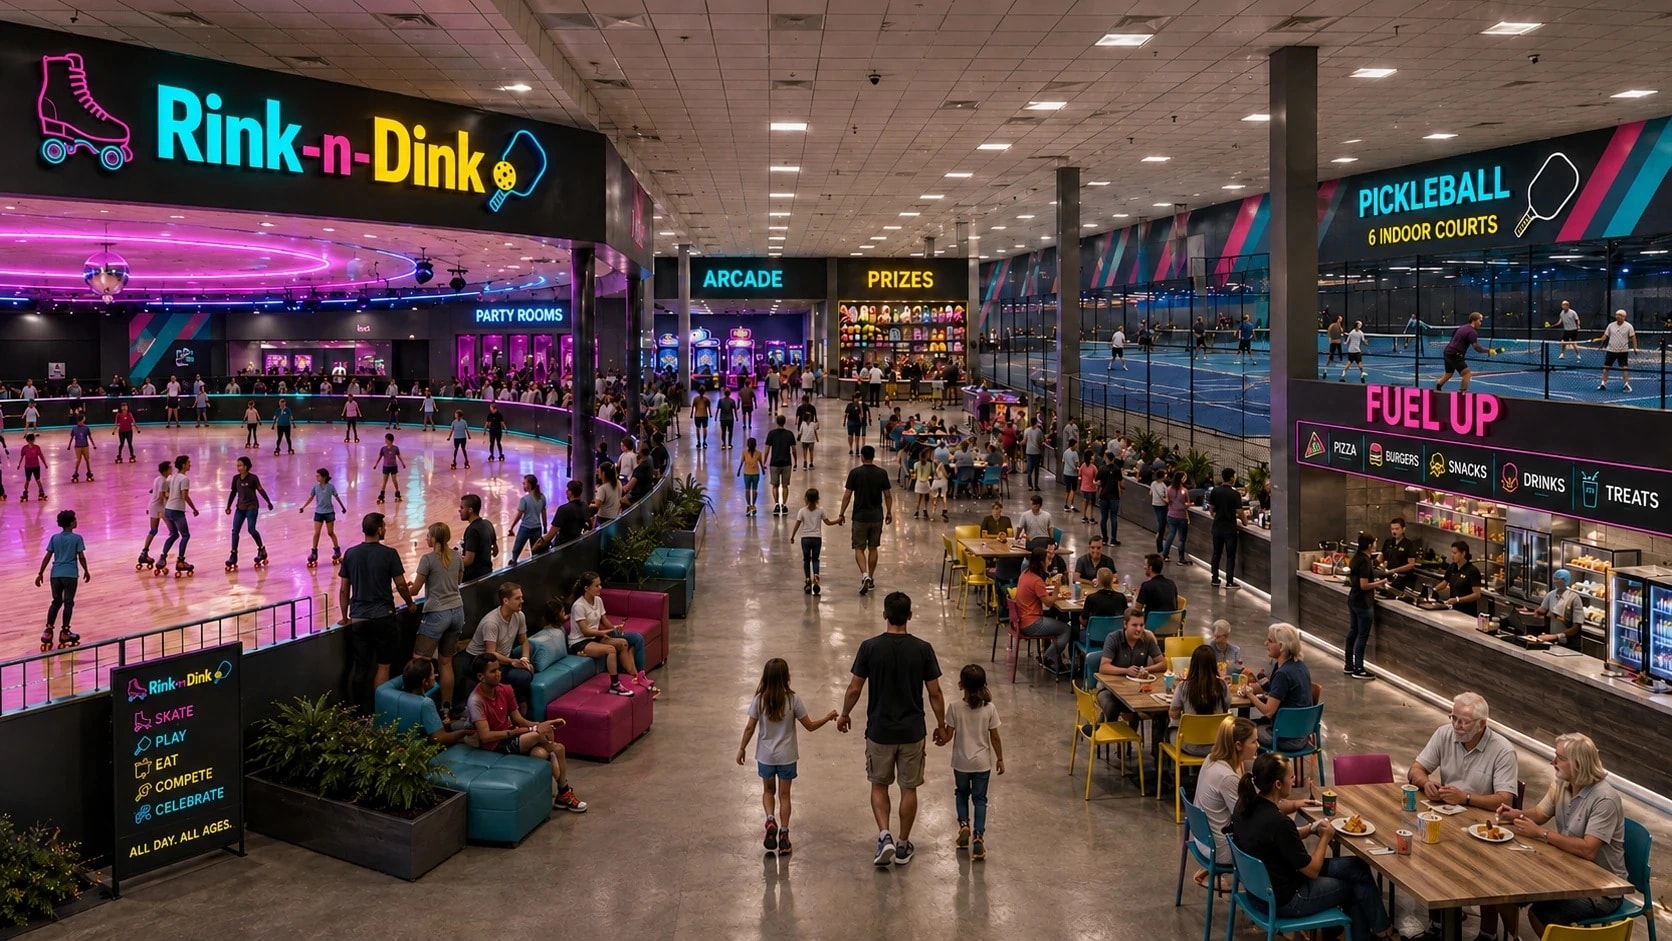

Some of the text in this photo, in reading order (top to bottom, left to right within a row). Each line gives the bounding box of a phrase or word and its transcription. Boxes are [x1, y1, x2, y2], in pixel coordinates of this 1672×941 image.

[157, 83, 486, 193] Rink-n-Dink
[1358, 165, 1511, 218] PICKLEBALL
[1368, 214, 1499, 246] 6 INDOOR COURTS
[702, 270, 783, 288] ARCADE
[868, 270, 934, 289] PRIZES
[475, 308, 563, 322] PARTY ROOMS
[1365, 384, 1499, 437] FUEL UP
[1333, 441, 1357, 457] PIZZA
[1385, 450, 1420, 467] BURGERS
[1448, 459, 1488, 479] SNACKS
[1523, 472, 1566, 493] DRINKS
[1605, 484, 1659, 509] TREATS
[155, 704, 194, 725] SKATE
[155, 729, 187, 748] PLAY
[155, 753, 179, 771] EAT
[155, 767, 213, 793] COMPETE
[155, 786, 225, 816] CELEBRATE
[129, 819, 232, 859] ALL DAY. ALL AGES.
